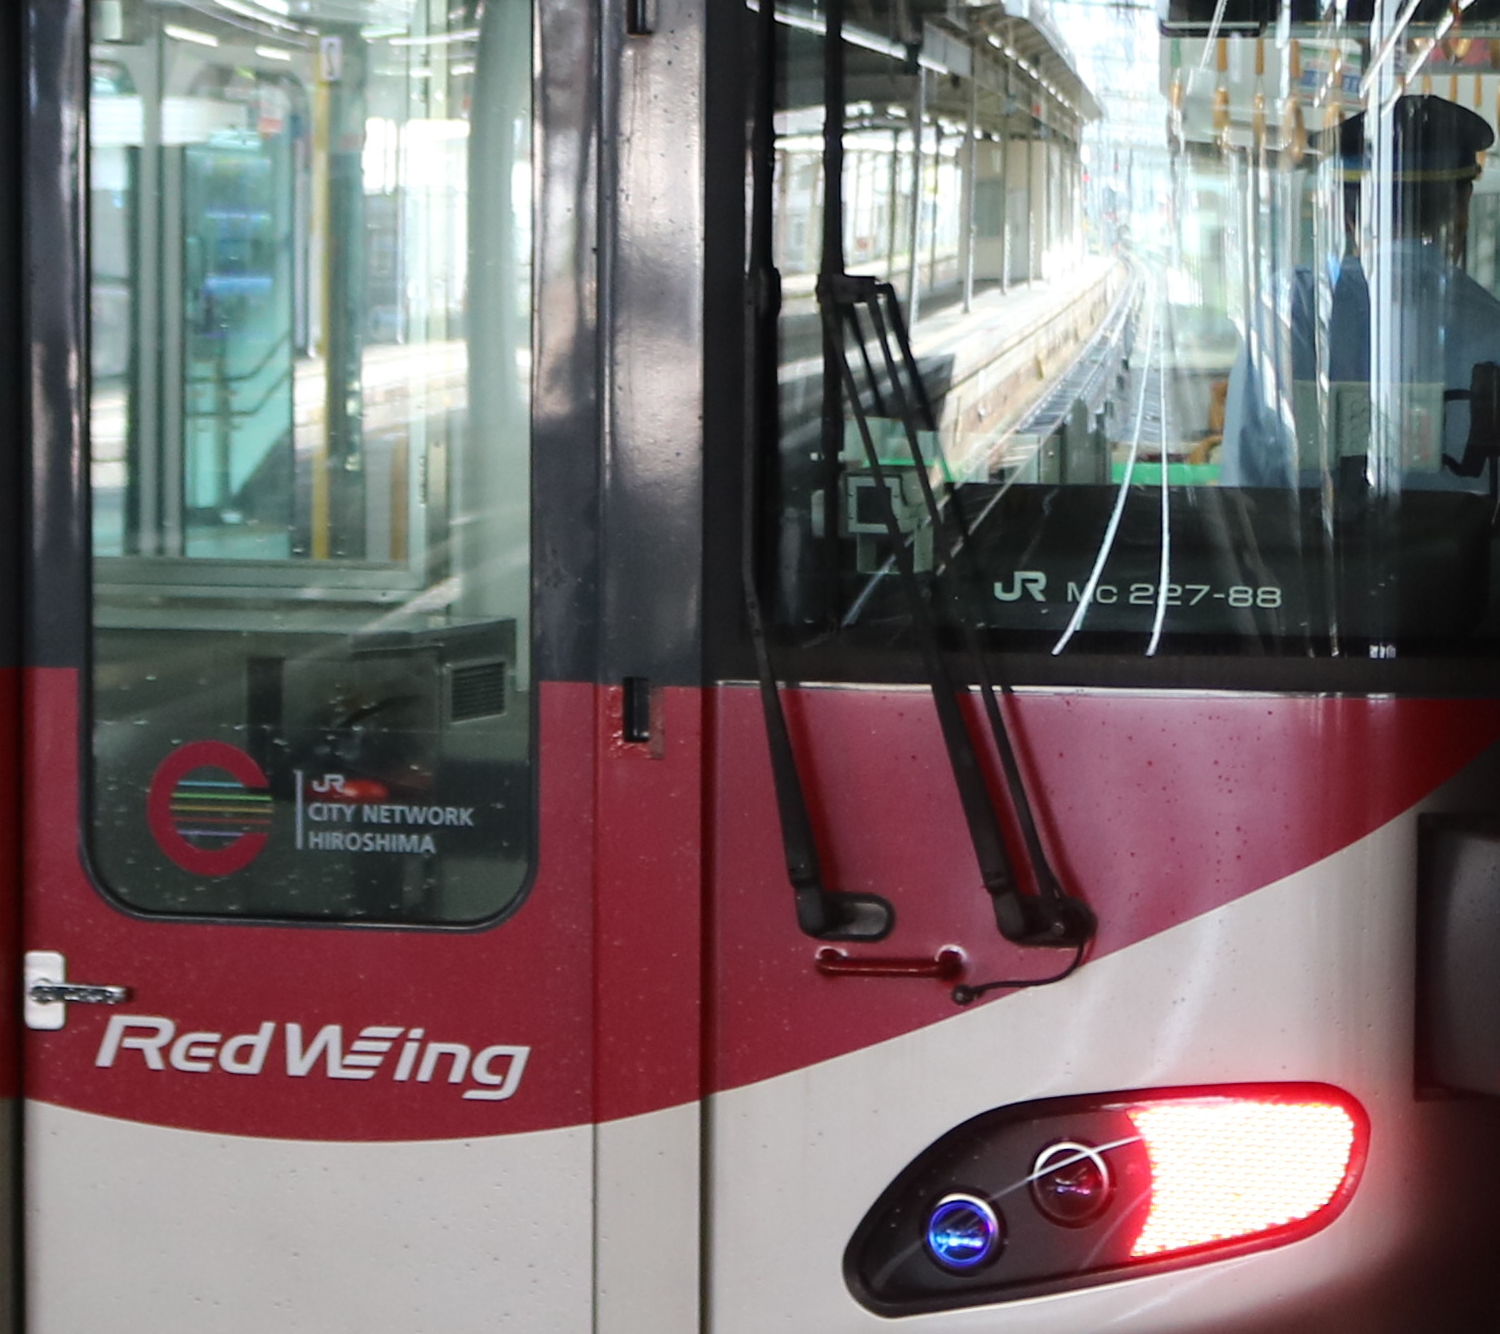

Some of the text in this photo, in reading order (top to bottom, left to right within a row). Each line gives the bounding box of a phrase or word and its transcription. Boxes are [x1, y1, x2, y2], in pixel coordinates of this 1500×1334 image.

[993, 570, 1048, 603] JR
[1128, 583, 1283, 609] 227-88
[311, 773, 346, 794] JR
[307, 803, 475, 827] CITY NETWORK
[307, 829, 437, 855] HIROSHIMA
